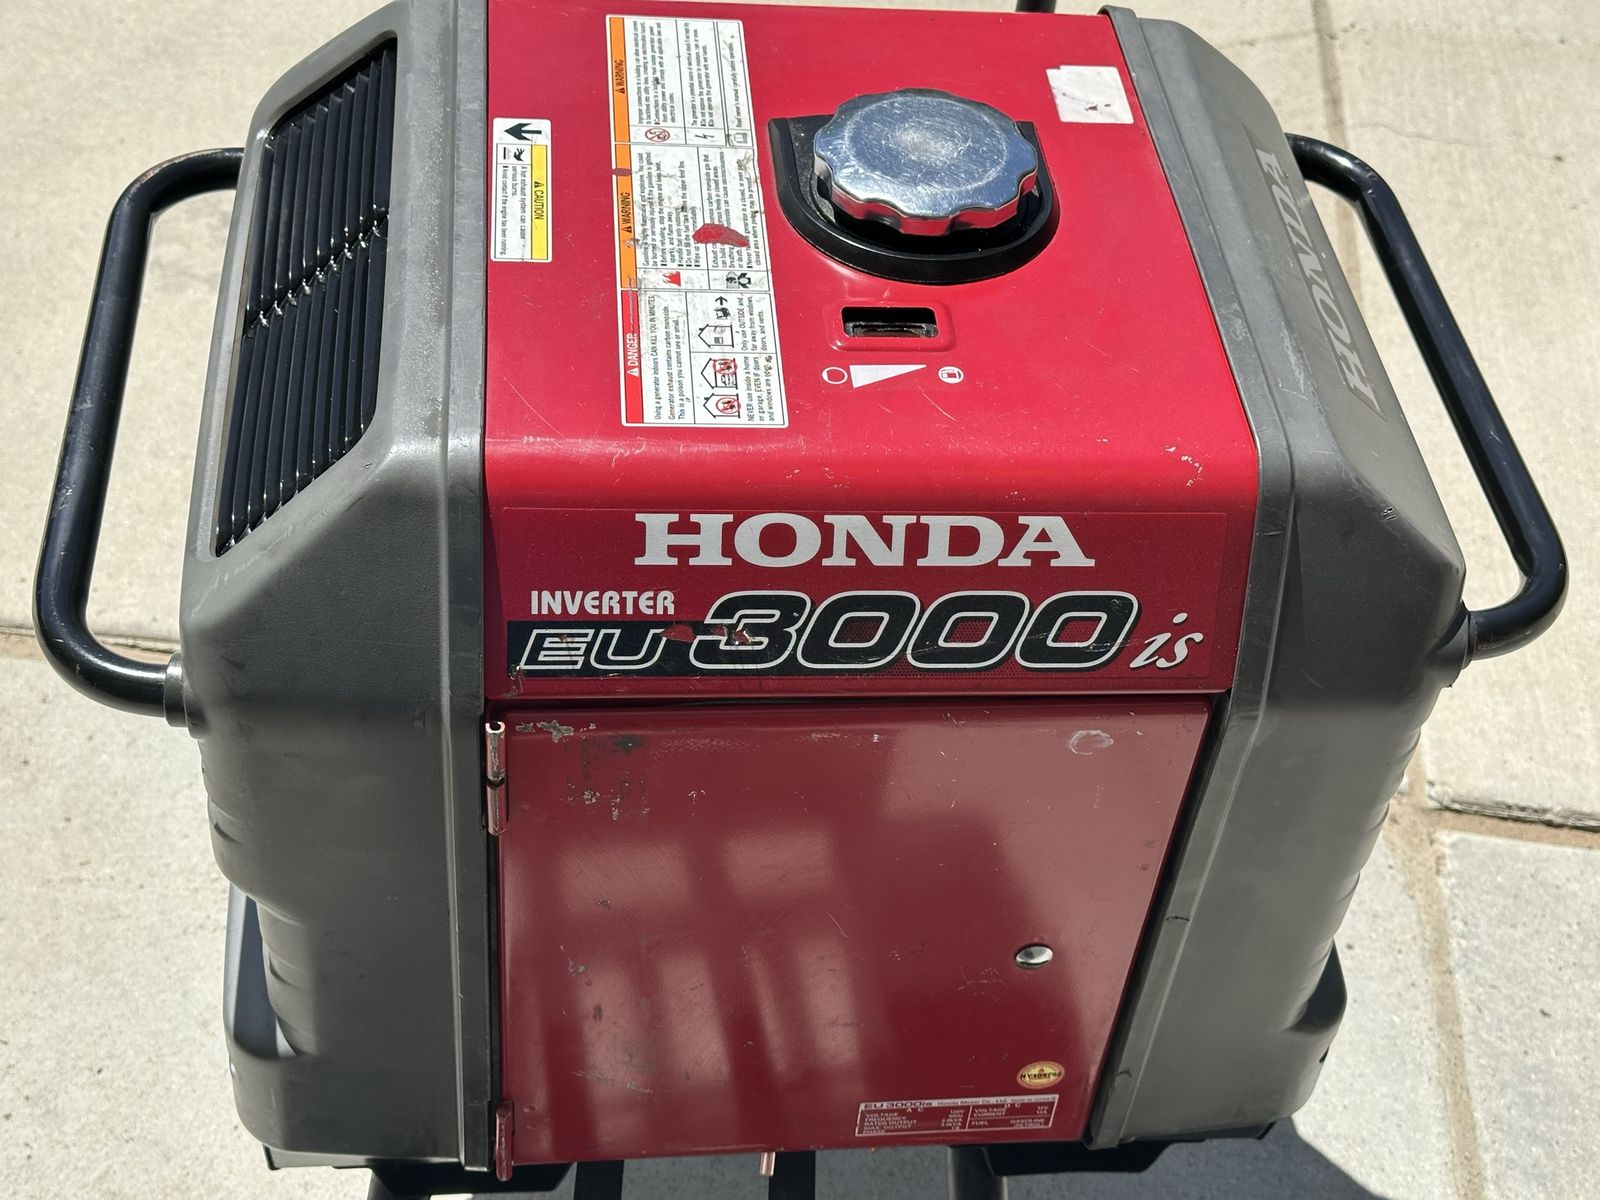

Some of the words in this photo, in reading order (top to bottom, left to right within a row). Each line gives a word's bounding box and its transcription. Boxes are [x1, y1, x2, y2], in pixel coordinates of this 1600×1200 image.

[614, 59, 625, 86] WARNING
[534, 190, 544, 220] CAUTION
[620, 192, 632, 225] WARNING
[1256, 149, 1380, 411] HONDA
[738, 308, 746, 328] OUTSIDE
[626, 333, 639, 366] DANGER
[741, 340, 749, 351] Only
[653, 377, 661, 400] generator
[676, 380, 685, 397] poison
[654, 406, 662, 420] Using
[634, 512, 1096, 567] HONDA
[531, 590, 675, 615] INVERTER
[520, 629, 666, 670] EU
[689, 590, 1138, 669] 3000
[1129, 612, 1204, 668] is
